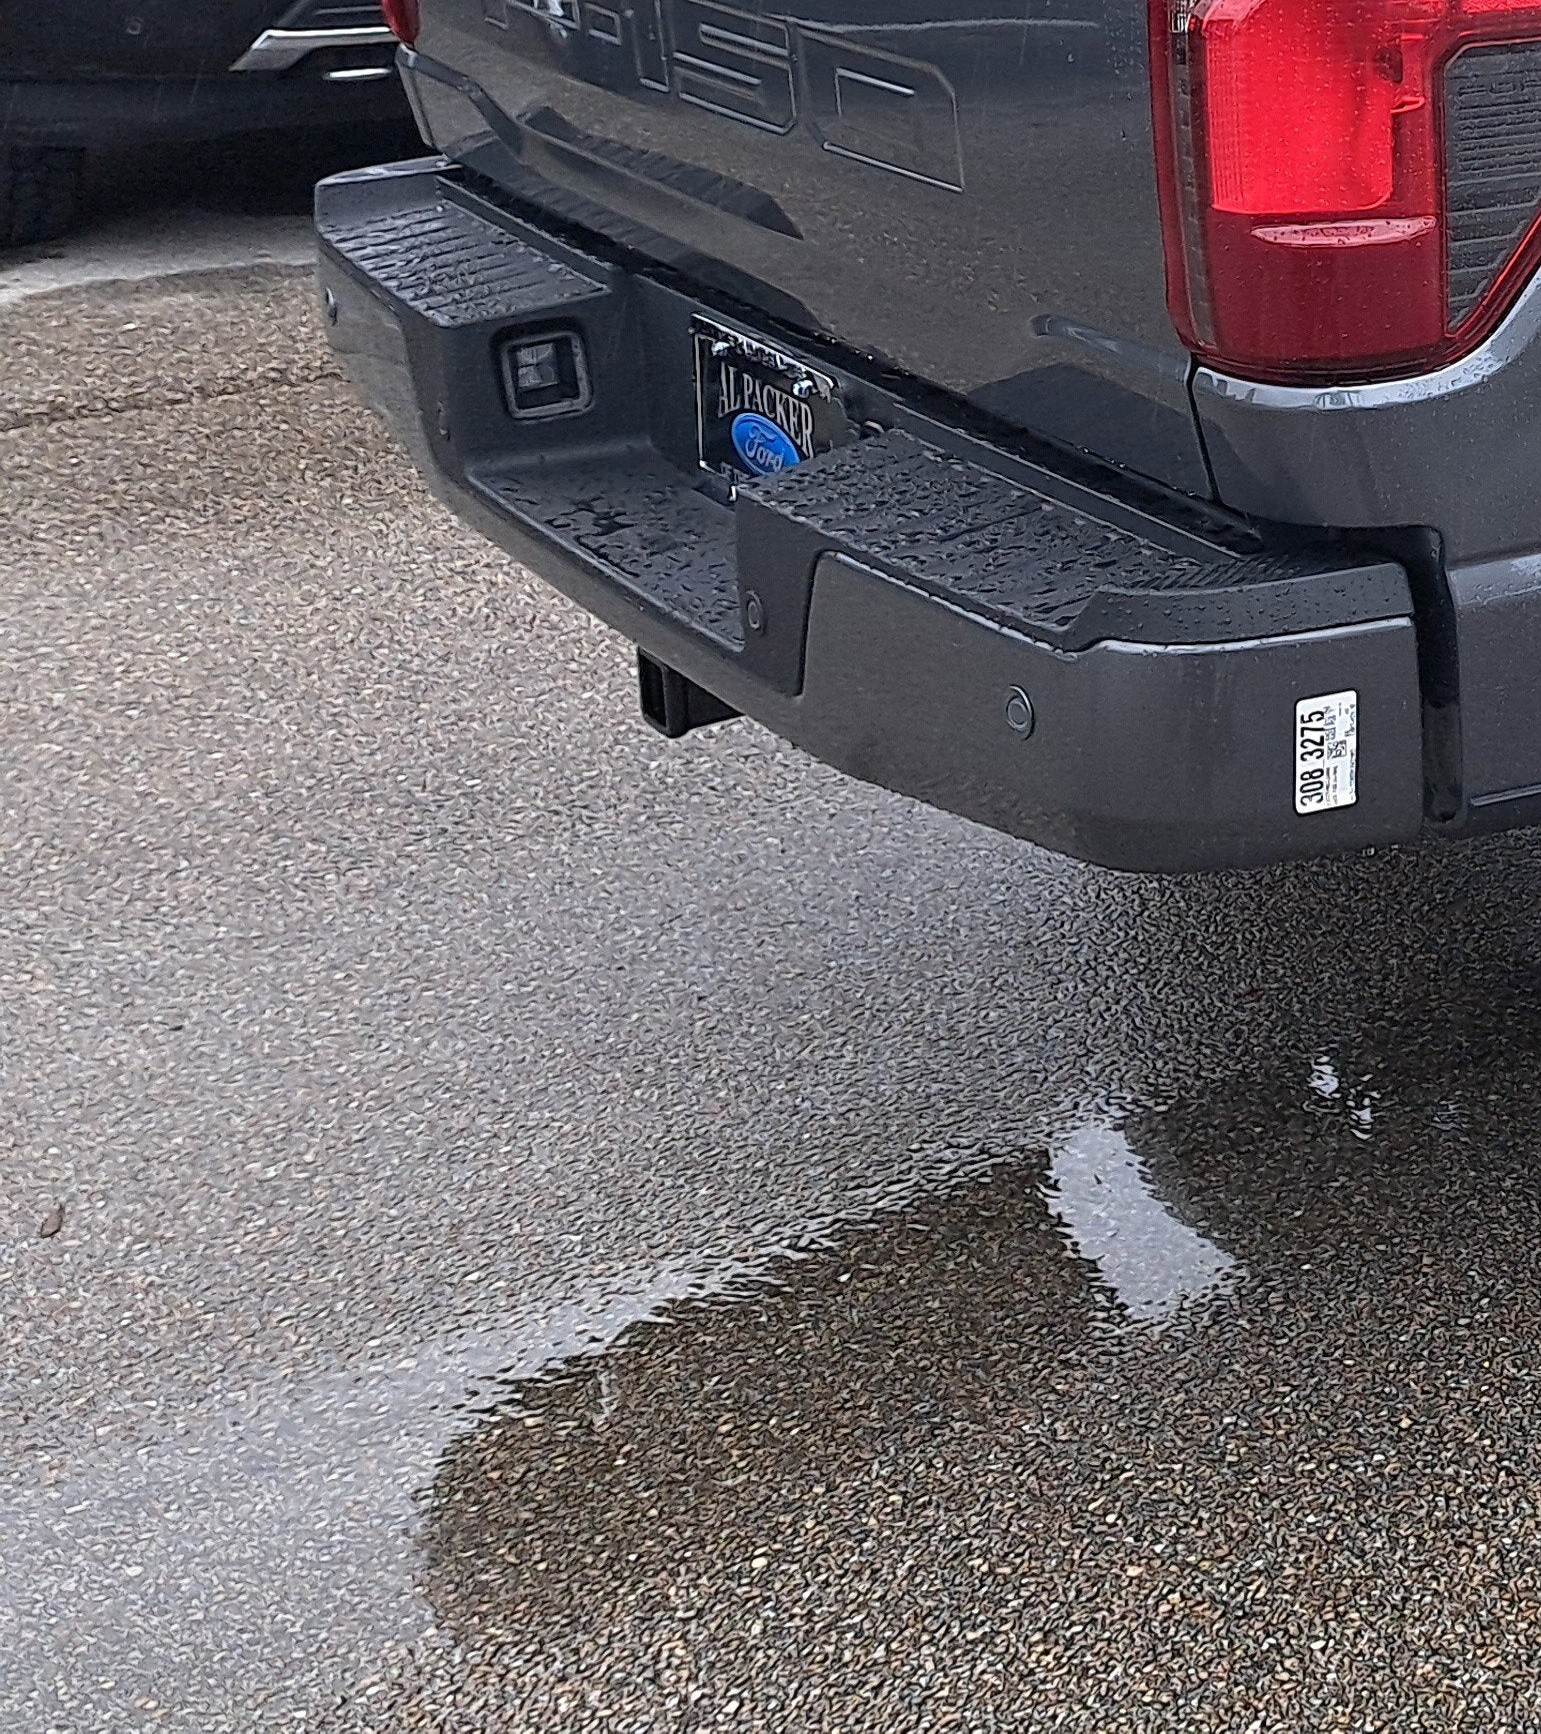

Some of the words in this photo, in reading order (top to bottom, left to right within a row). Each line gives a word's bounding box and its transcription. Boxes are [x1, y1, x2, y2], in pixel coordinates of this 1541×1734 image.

[718, 361, 742, 418] AL
[742, 372, 815, 460] PACKER
[1299, 709, 1325, 762] 3275
[1299, 767, 1324, 807] 308
